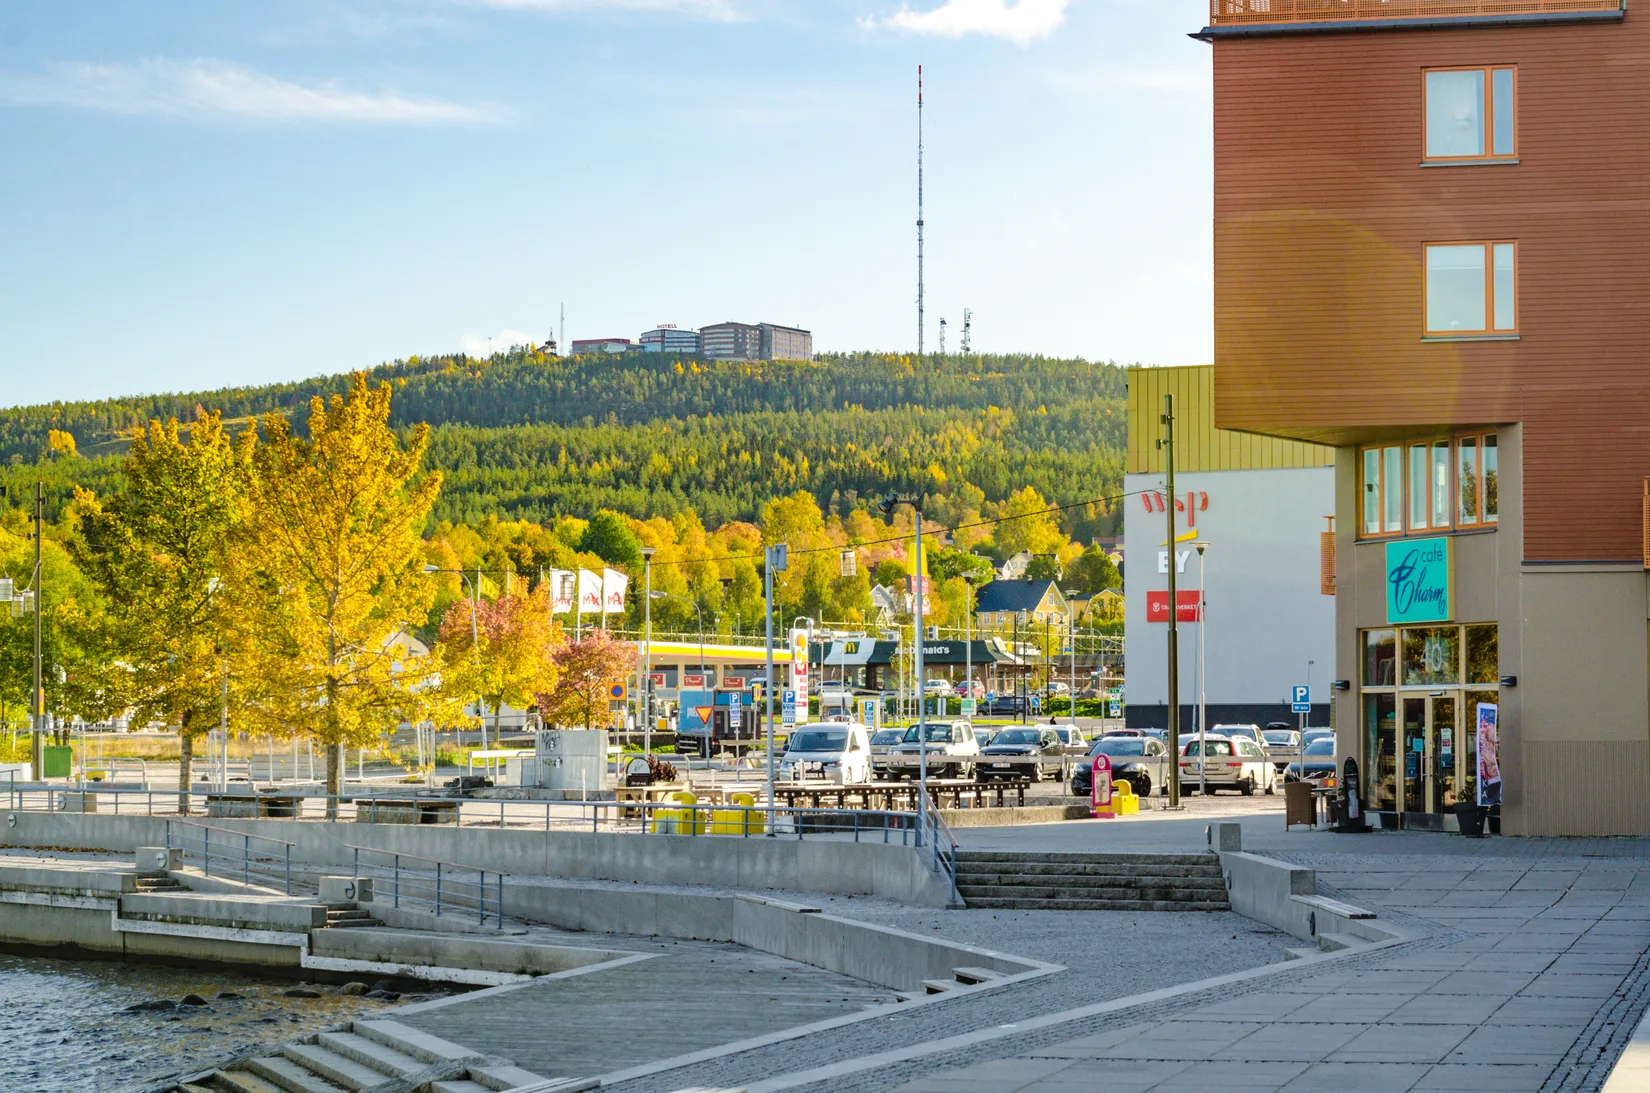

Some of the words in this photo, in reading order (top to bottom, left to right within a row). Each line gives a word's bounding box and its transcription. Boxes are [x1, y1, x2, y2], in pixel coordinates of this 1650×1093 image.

[1421, 543, 1443, 562] café
[1158, 550, 1191, 574] EY
[1389, 549, 1446, 615] Charm
[894, 646, 950, 655] McDnald's
[732, 693, 737, 703] P
[786, 691, 793, 702] P
[1296, 687, 1307, 702] P
